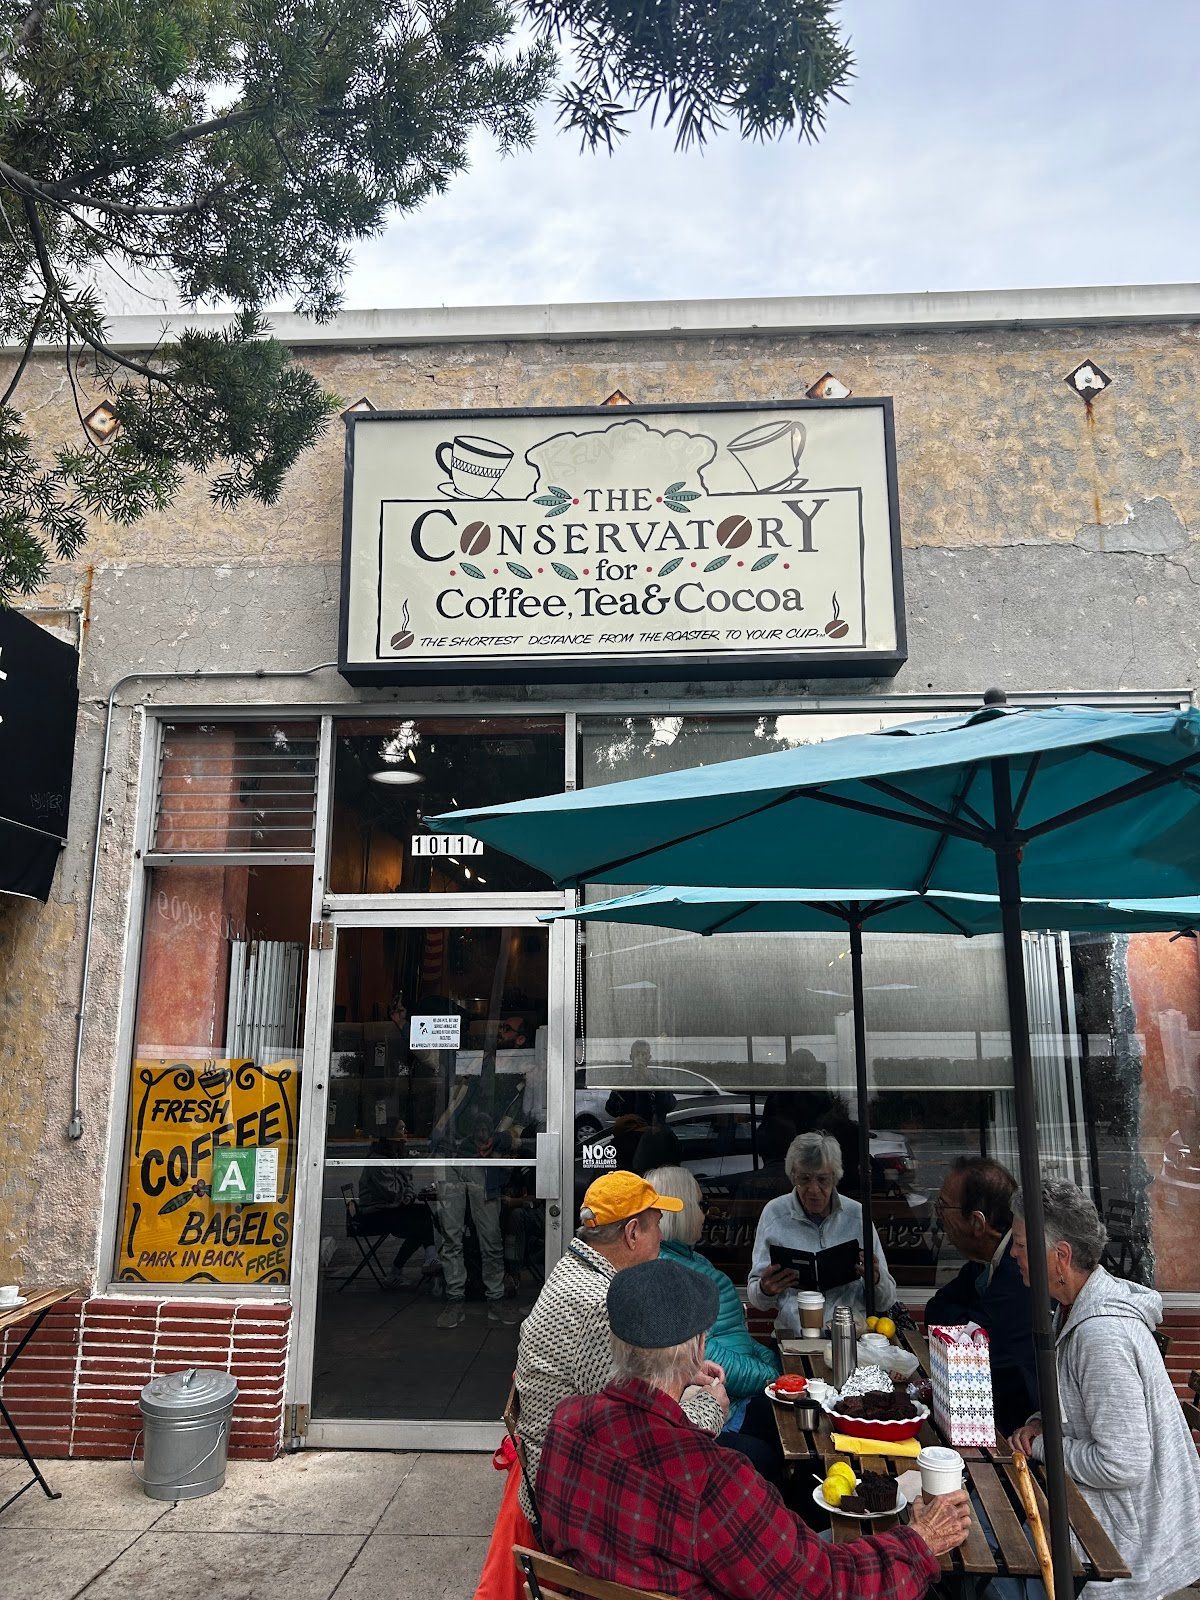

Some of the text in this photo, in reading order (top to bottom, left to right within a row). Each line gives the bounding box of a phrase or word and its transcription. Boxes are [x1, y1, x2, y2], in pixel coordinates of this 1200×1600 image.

[583, 488, 653, 512] THE
[595, 558, 638, 581] for
[420, 637, 448, 647] THE
[448, 635, 523, 647] SHORTEST
[528, 634, 594, 645] DISTANCE
[598, 633, 635, 643] FROM
[639, 632, 662, 642] THE
[662, 629, 720, 641] ROASTER
[725, 629, 742, 640] TO
[745, 628, 783, 640] YOUR
[151, 1099, 230, 1125] FRESH
[582, 1145, 604, 1159] NO
[217, 1160, 247, 1192] A
[177, 1210, 290, 1248] BAGELS
[137, 1246, 286, 1277] PARK IN BACK FREE
